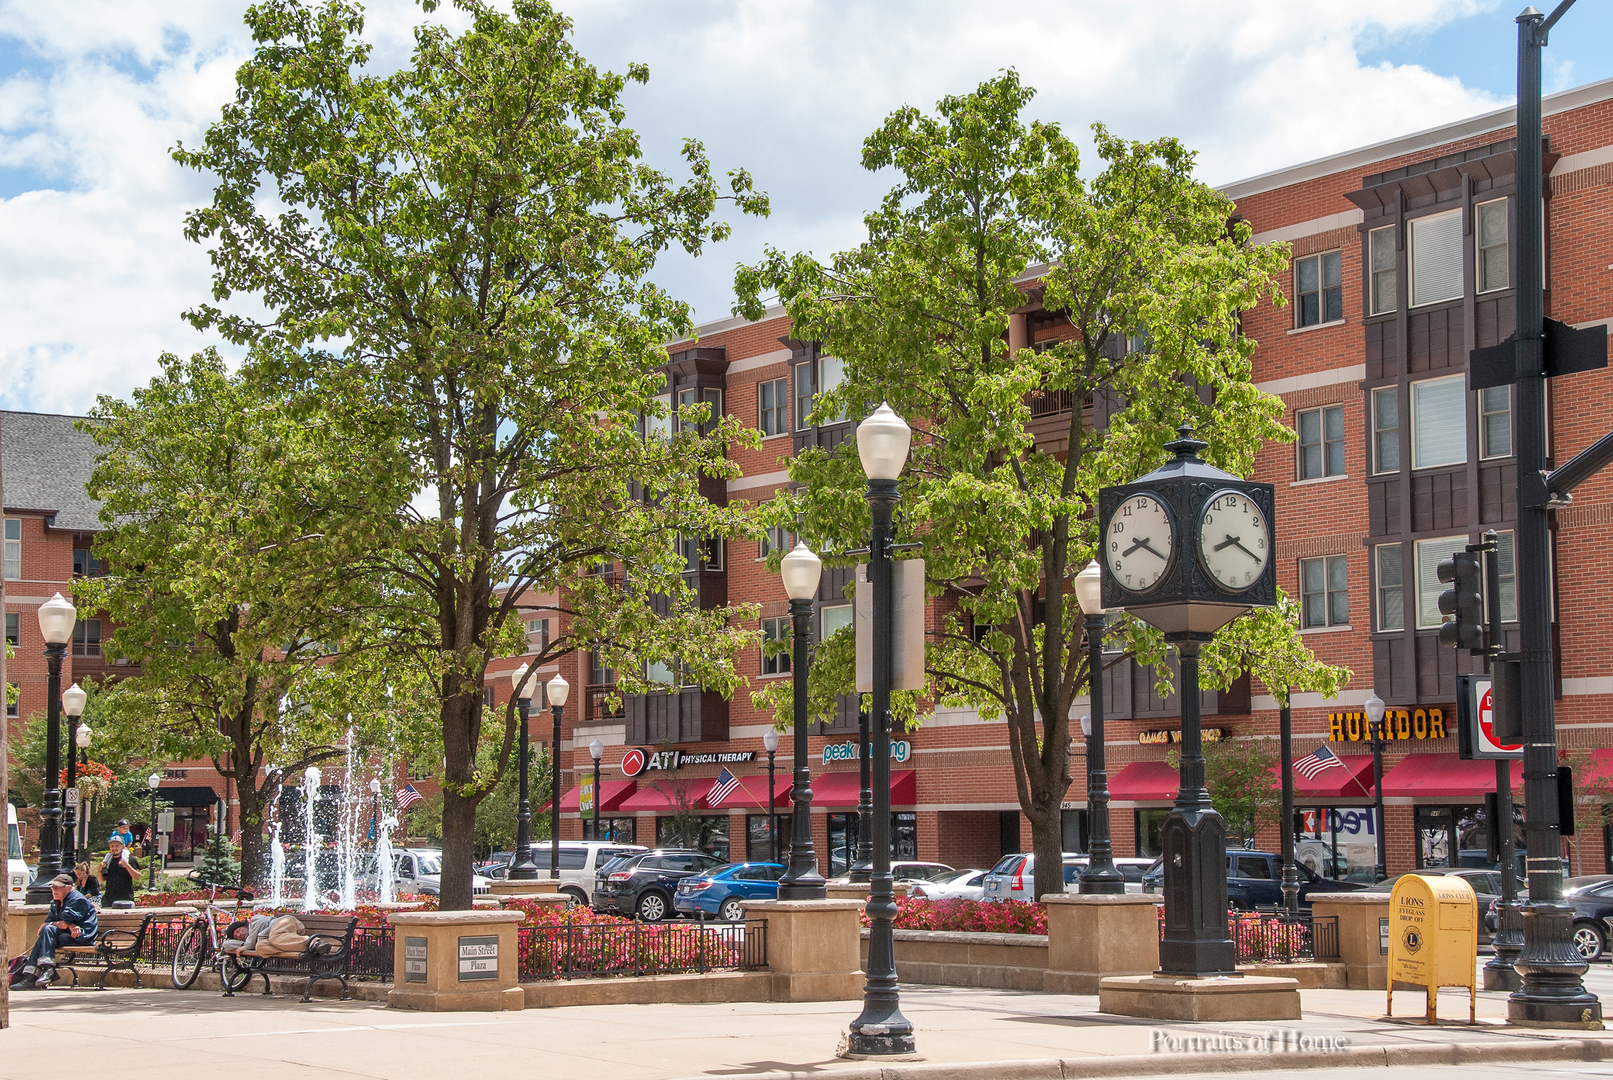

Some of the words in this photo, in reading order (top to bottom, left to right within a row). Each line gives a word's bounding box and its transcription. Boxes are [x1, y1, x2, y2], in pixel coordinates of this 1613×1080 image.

[1136, 498, 1148, 509] 12
[1154, 503, 1159, 512] 1
[1225, 497, 1236, 507] 12
[1122, 505, 1132, 516] 11
[1243, 503, 1248, 513] 1
[1252, 516, 1259, 527] 2
[1113, 522, 1124, 533] 10
[1111, 541, 1118, 552] 9
[1258, 538, 1264, 549] 3
[1115, 560, 1122, 571] 8
[1125, 574, 1132, 585] 7
[1153, 571, 1159, 582] 5
[1244, 571, 1251, 581] 5
[1139, 577, 1146, 589] 6
[1140, 731, 1168, 744] GAMES
[680, 754, 717, 764] PHYSICAL
[717, 752, 753, 762] THERAPY
[823, 740, 855, 765] peak
[646, 751, 680, 770] ATI
[580, 800, 593, 811] LIVE
[1400, 897, 1424, 907] LIONS
[1399, 908, 1425, 916] EYEGLASS
[1414, 915, 1424, 923] OFF
[1410, 934, 1416, 945] L
[406, 947, 416, 956] Main
[416, 947, 426, 956] Street
[461, 946, 477, 956] Main
[478, 945, 495, 956] Street
[470, 960, 487, 970] Plaza
